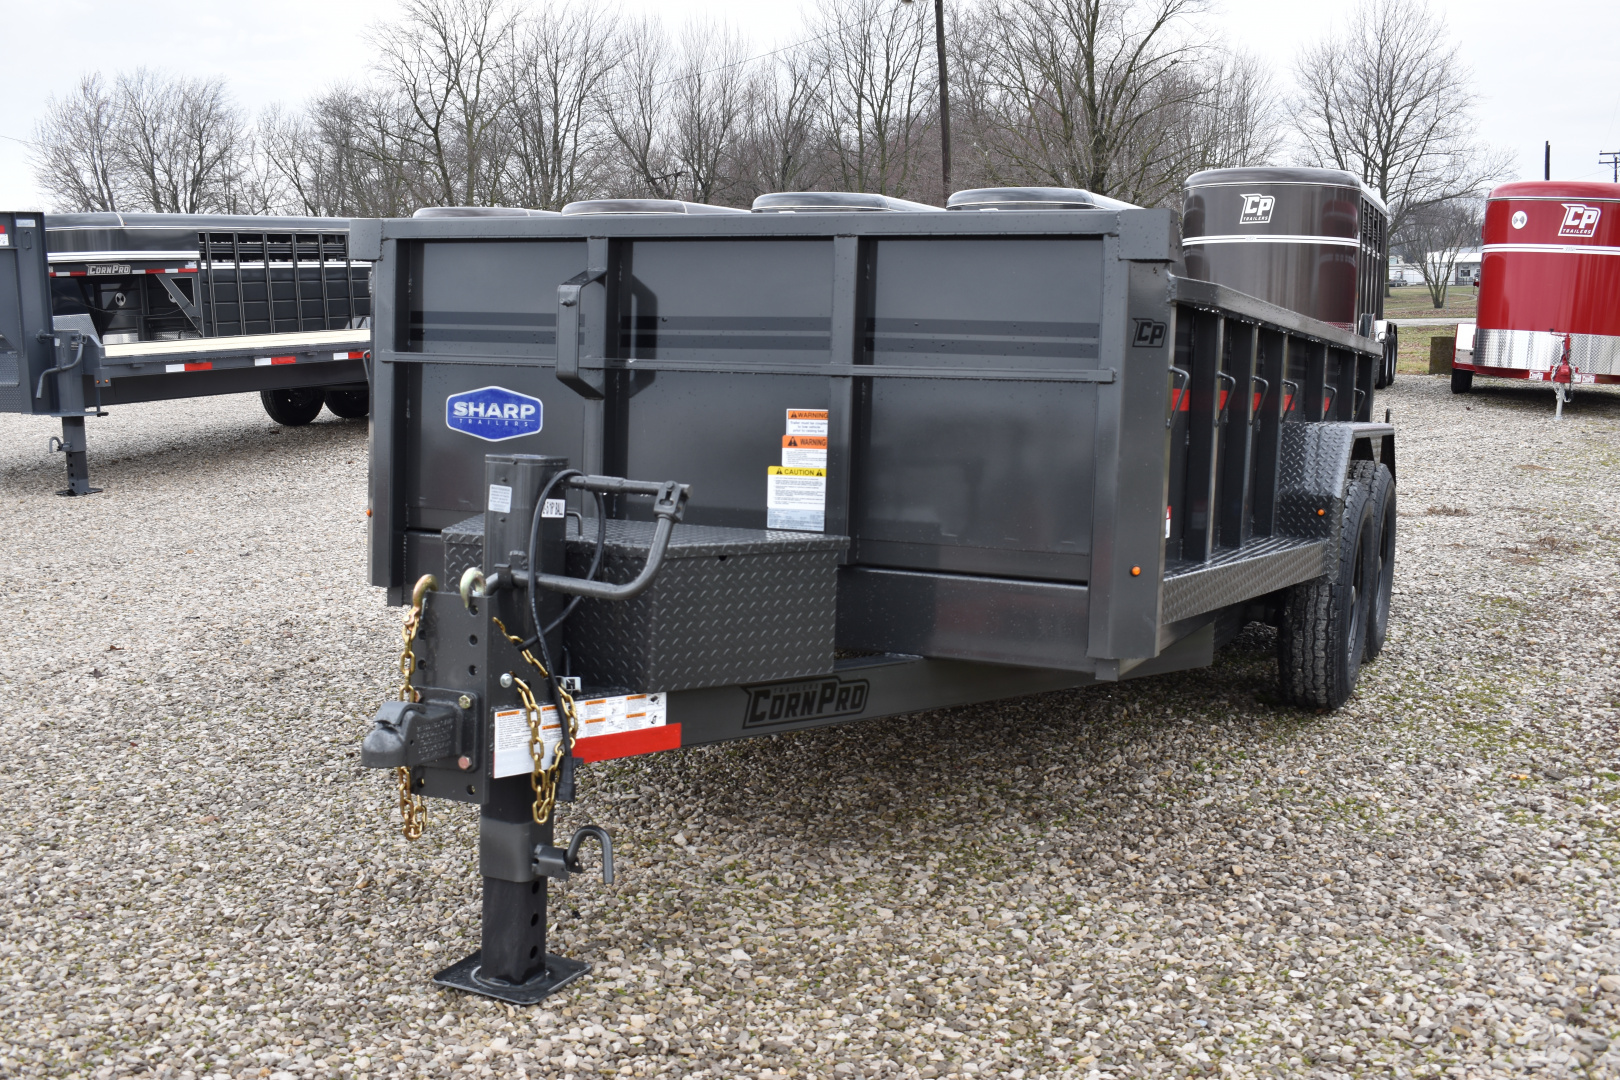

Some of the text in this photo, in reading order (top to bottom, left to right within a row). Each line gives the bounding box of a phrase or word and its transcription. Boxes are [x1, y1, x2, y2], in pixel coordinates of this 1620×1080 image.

[1245, 196, 1273, 216] CP
[1565, 206, 1598, 229] CP
[1136, 321, 1165, 345] CP
[452, 401, 536, 419] SHARP
[459, 418, 528, 427] TRAILERS
[800, 438, 827, 446] WARNING
